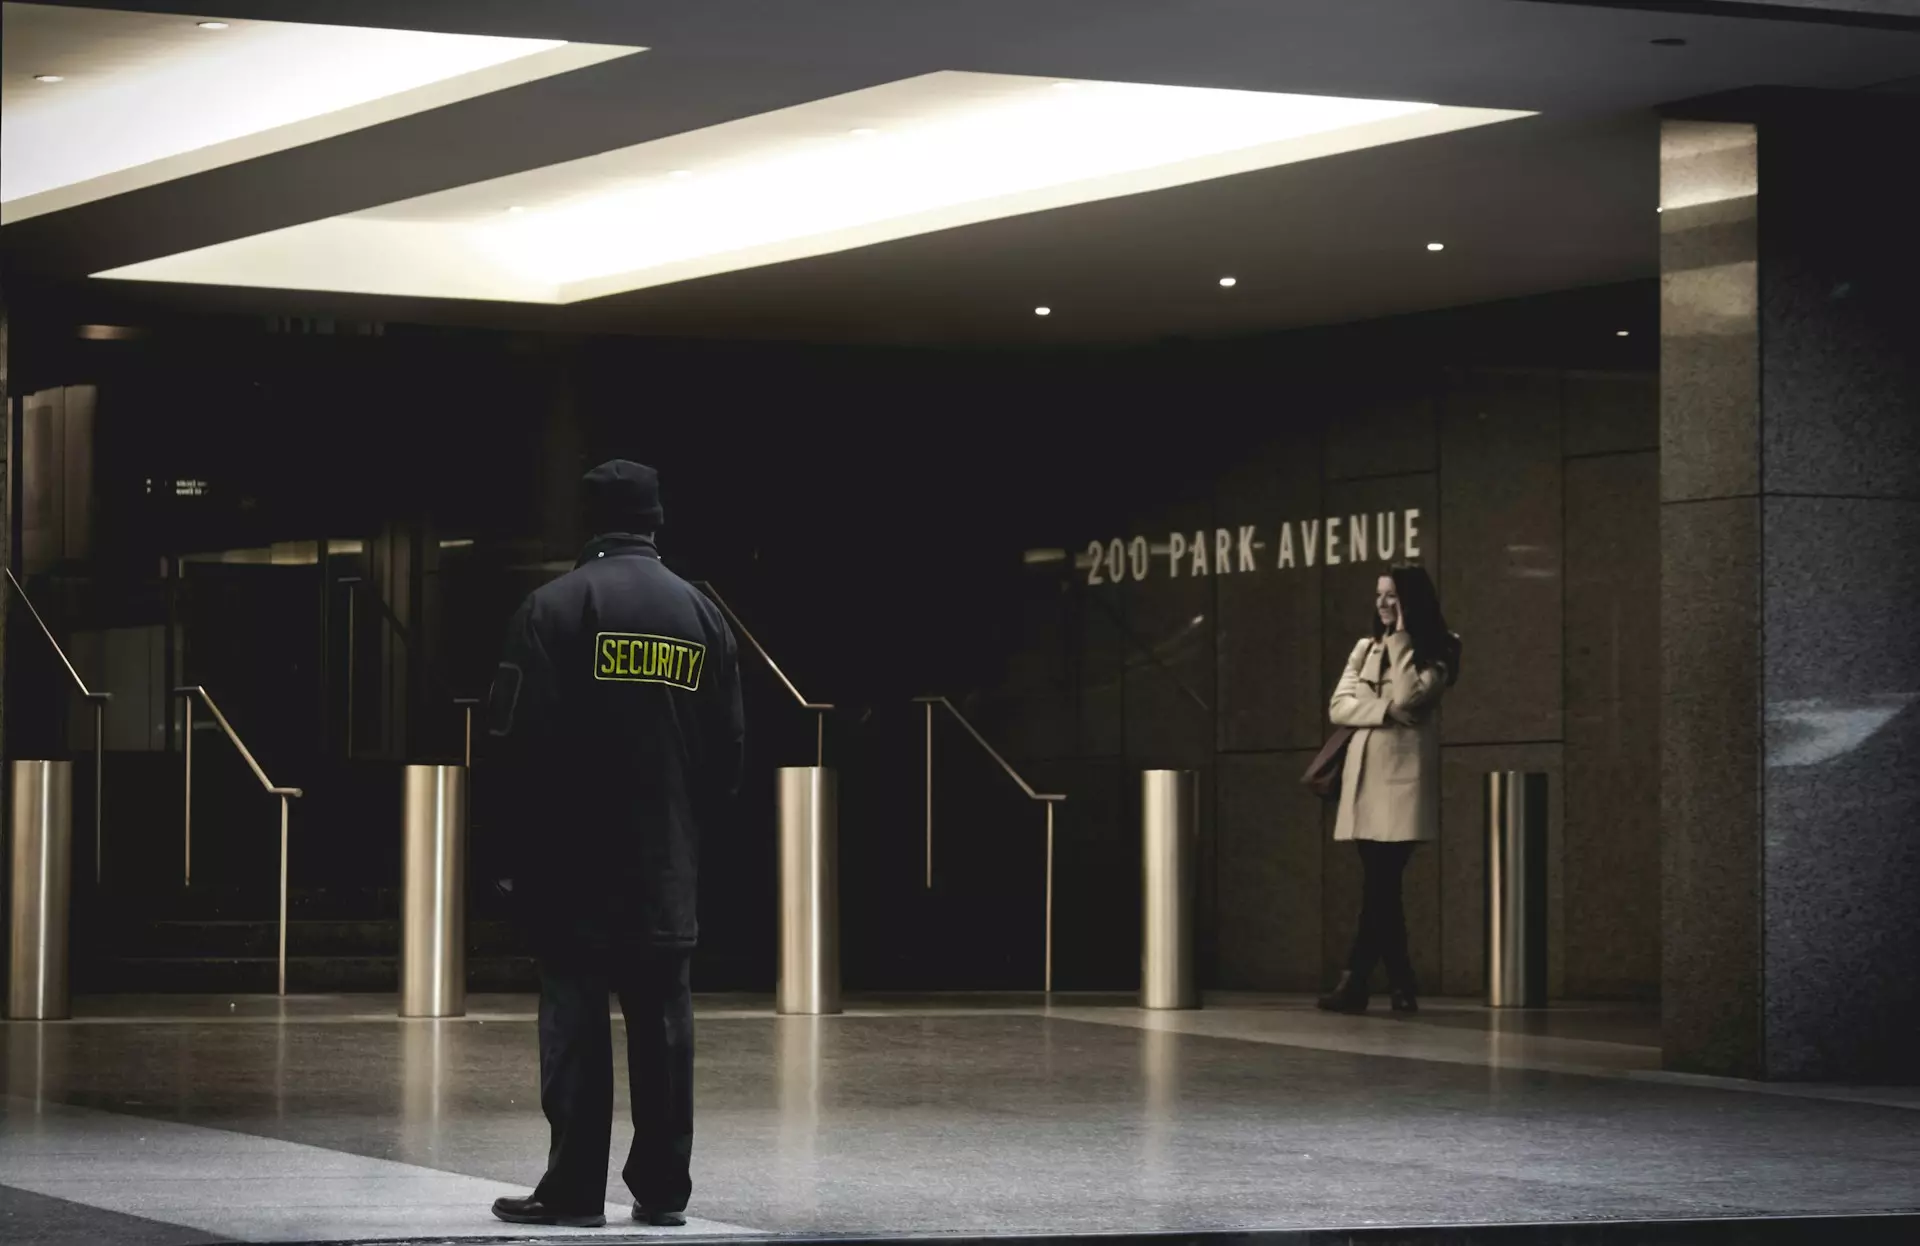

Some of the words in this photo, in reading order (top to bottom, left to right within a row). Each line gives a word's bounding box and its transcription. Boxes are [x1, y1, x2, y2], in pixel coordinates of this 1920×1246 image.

[1087, 535, 1149, 585] 200
[1170, 525, 1256, 577] PARK
[1277, 508, 1420, 569] AVENUE
[601, 639, 700, 683] SECURITY
